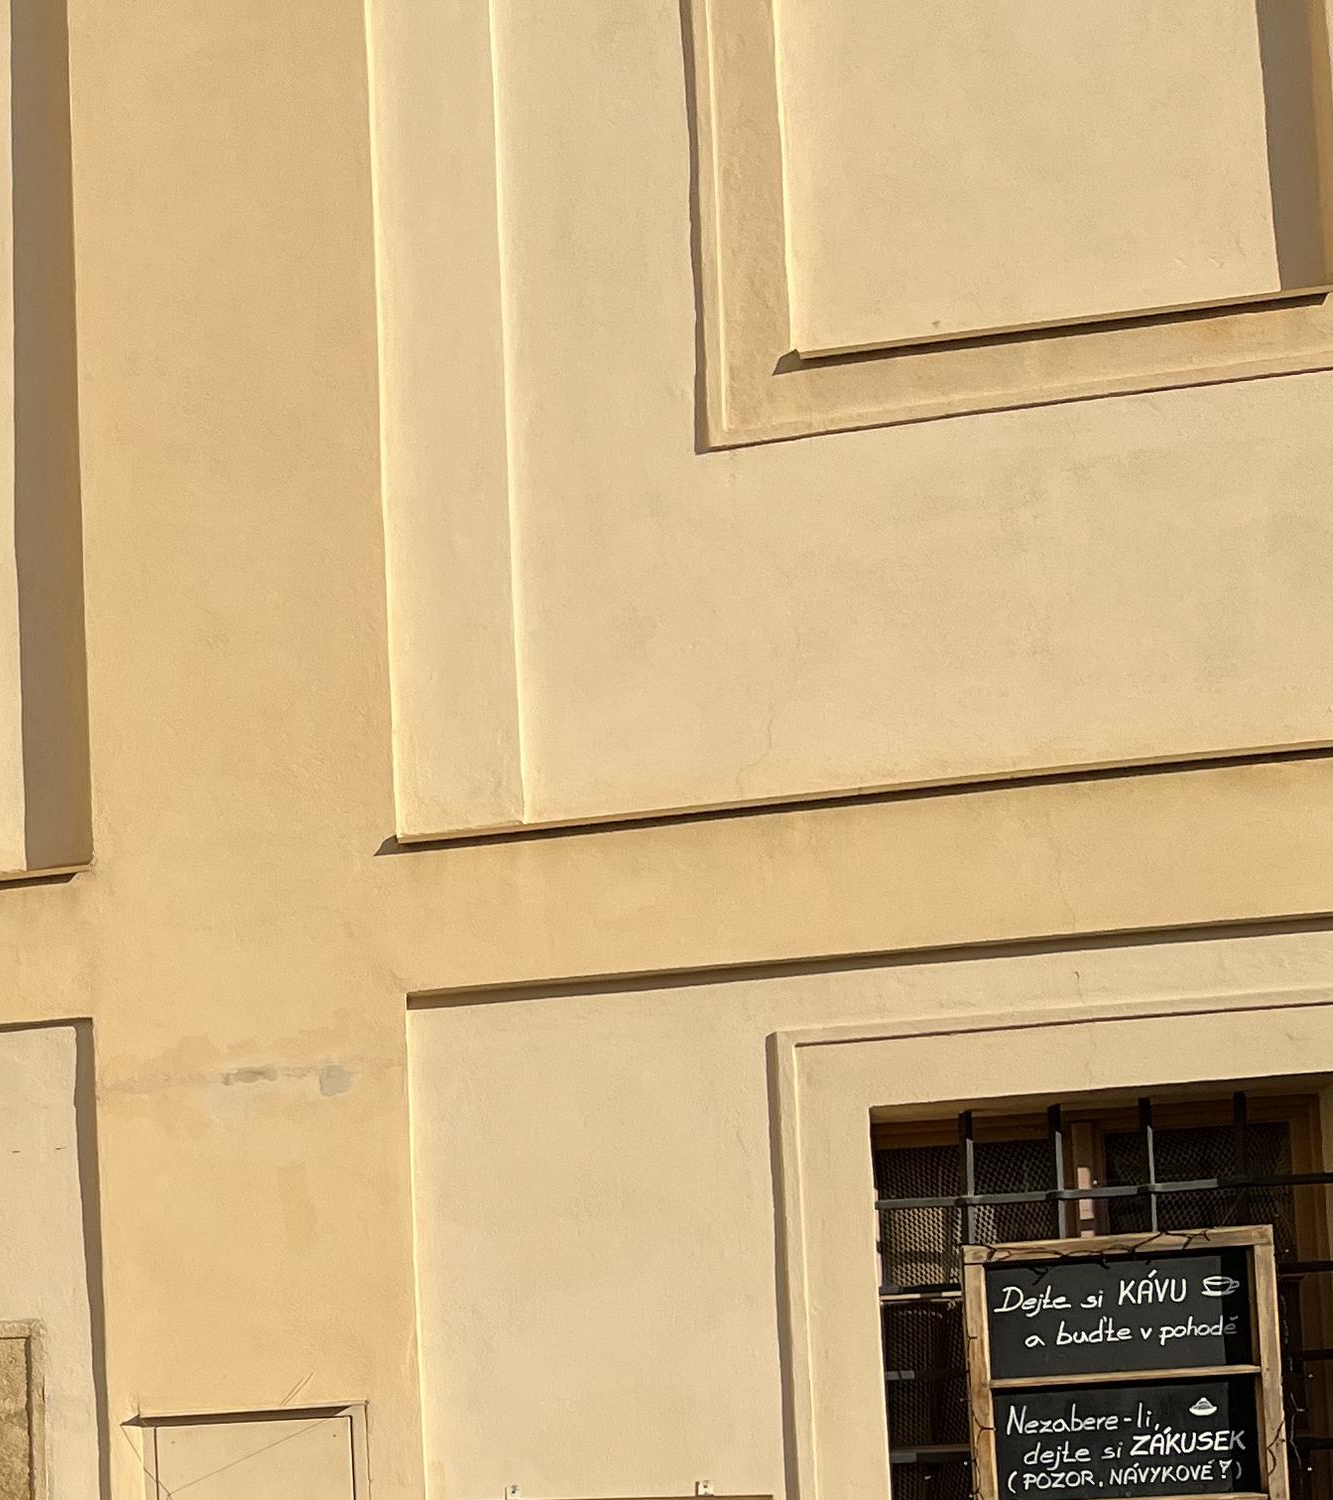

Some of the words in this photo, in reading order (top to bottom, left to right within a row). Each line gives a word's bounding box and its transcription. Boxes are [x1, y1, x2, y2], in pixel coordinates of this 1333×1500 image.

[994, 1286, 1071, 1317] Dejte
[1081, 1290, 1104, 1308] si
[1118, 1270, 1187, 1306] KÁVU
[1025, 1334, 1045, 1348] a
[1056, 1316, 1133, 1346] buďte
[1140, 1327, 1153, 1340] v
[1159, 1315, 1239, 1346] pohodě
[1006, 1402, 1160, 1436] Nezabere-li,
[1024, 1440, 1091, 1470] dejte
[1101, 1442, 1123, 1460] si
[1130, 1426, 1246, 1456] ZÁKUSEK
